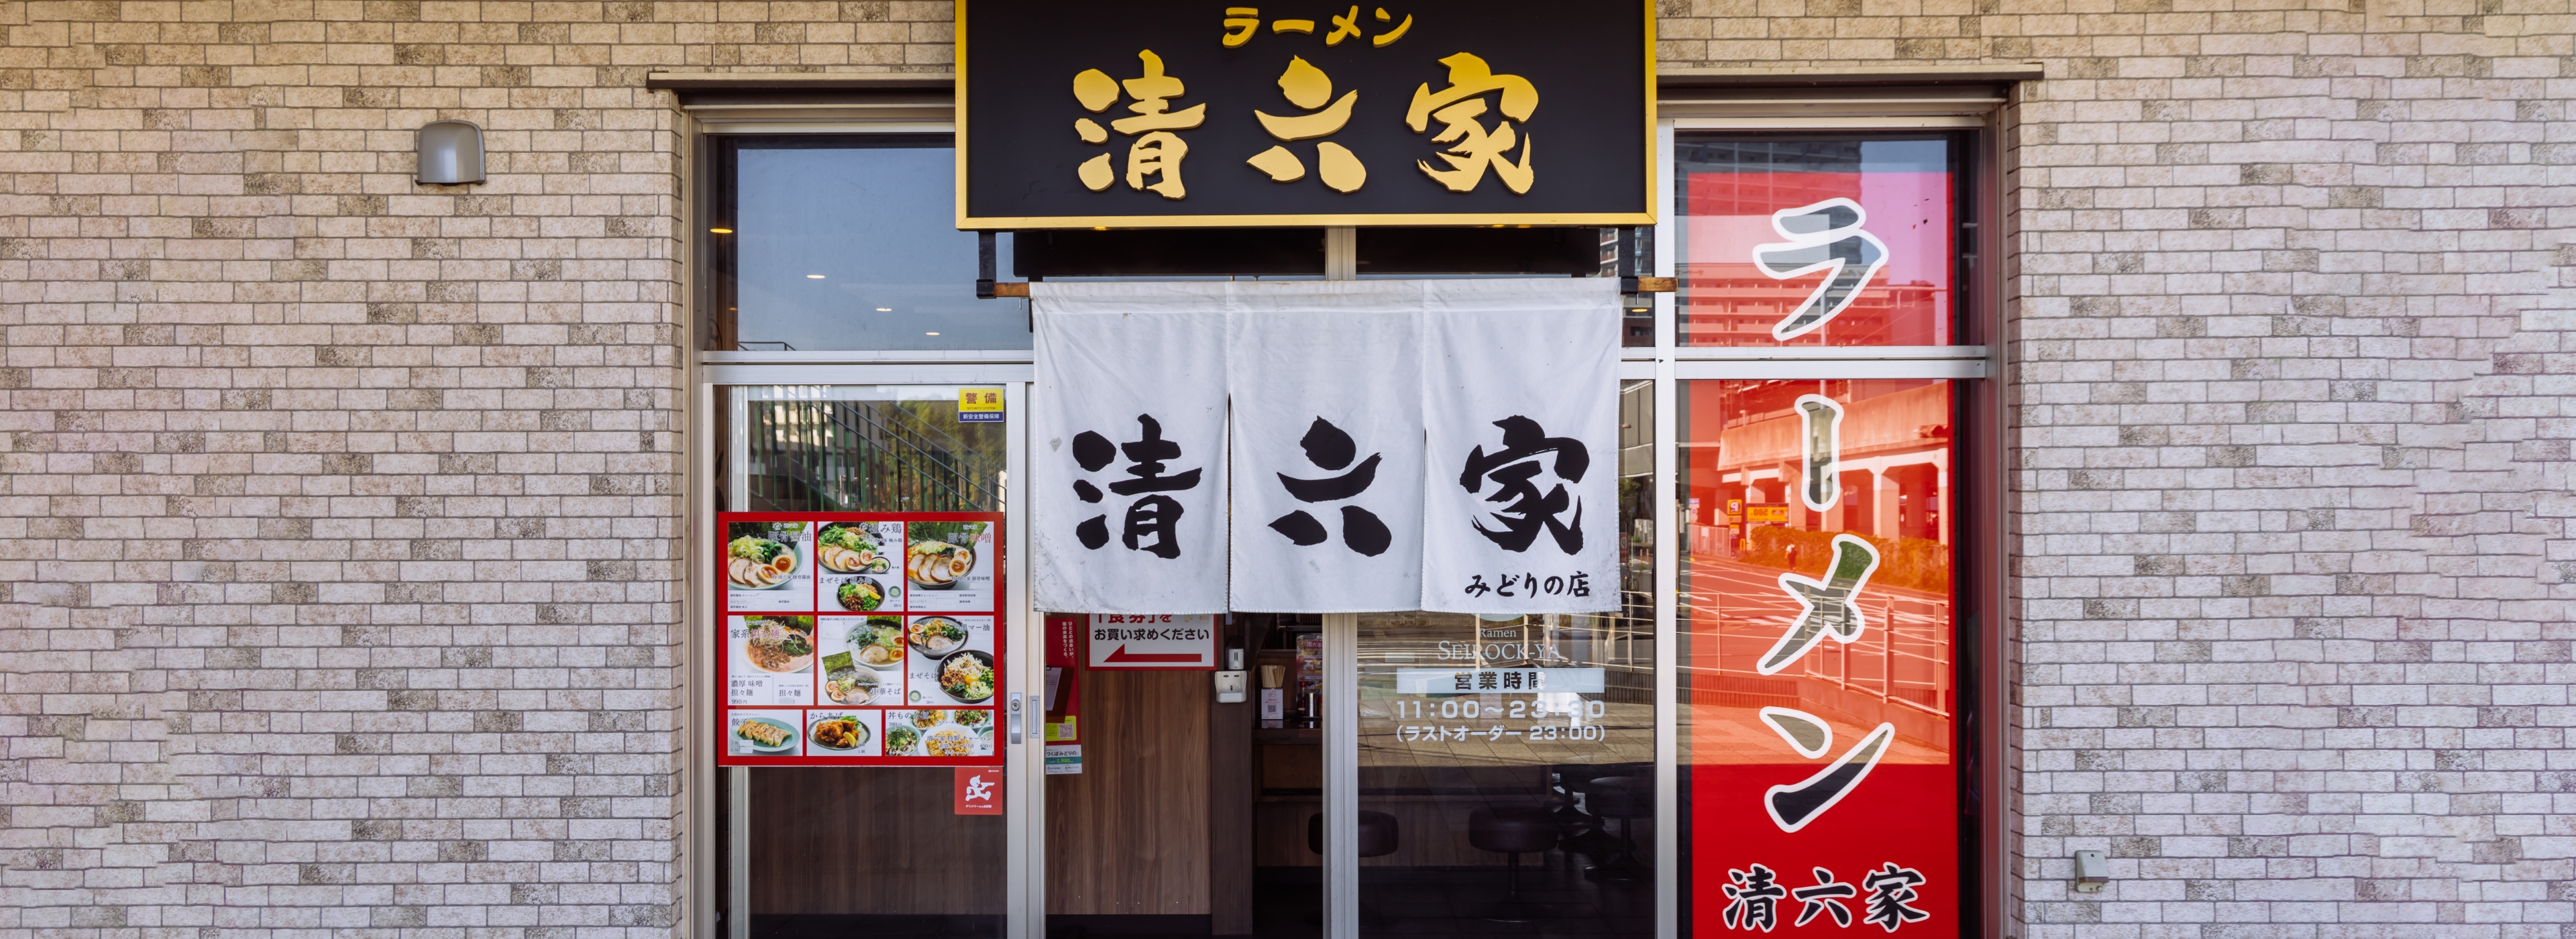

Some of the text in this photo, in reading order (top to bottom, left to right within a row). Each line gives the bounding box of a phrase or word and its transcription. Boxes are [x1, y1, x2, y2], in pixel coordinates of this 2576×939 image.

[1222, 6, 1413, 48] ラーメン
[1073, 49, 1539, 201] 清六家
[965, 392, 998, 404] 警備
[1072, 413, 1591, 559] 清六家
[1752, 197, 1895, 834] ラーメン
[767, 531, 812, 543] 豚骨醤油
[947, 532, 991, 544] 豚骨味噌
[1464, 571, 1591, 599] みどりの店
[1094, 628, 1210, 641] お買い求めください
[1479, 628, 1517, 637] Ramen
[1454, 671, 1546, 690] 営業時間
[871, 687, 902, 696] 中華そば
[731, 718, 749, 726] 餃子
[1529, 725, 1605, 742] 23:00)
[1722, 862, 1931, 933] 清六家
